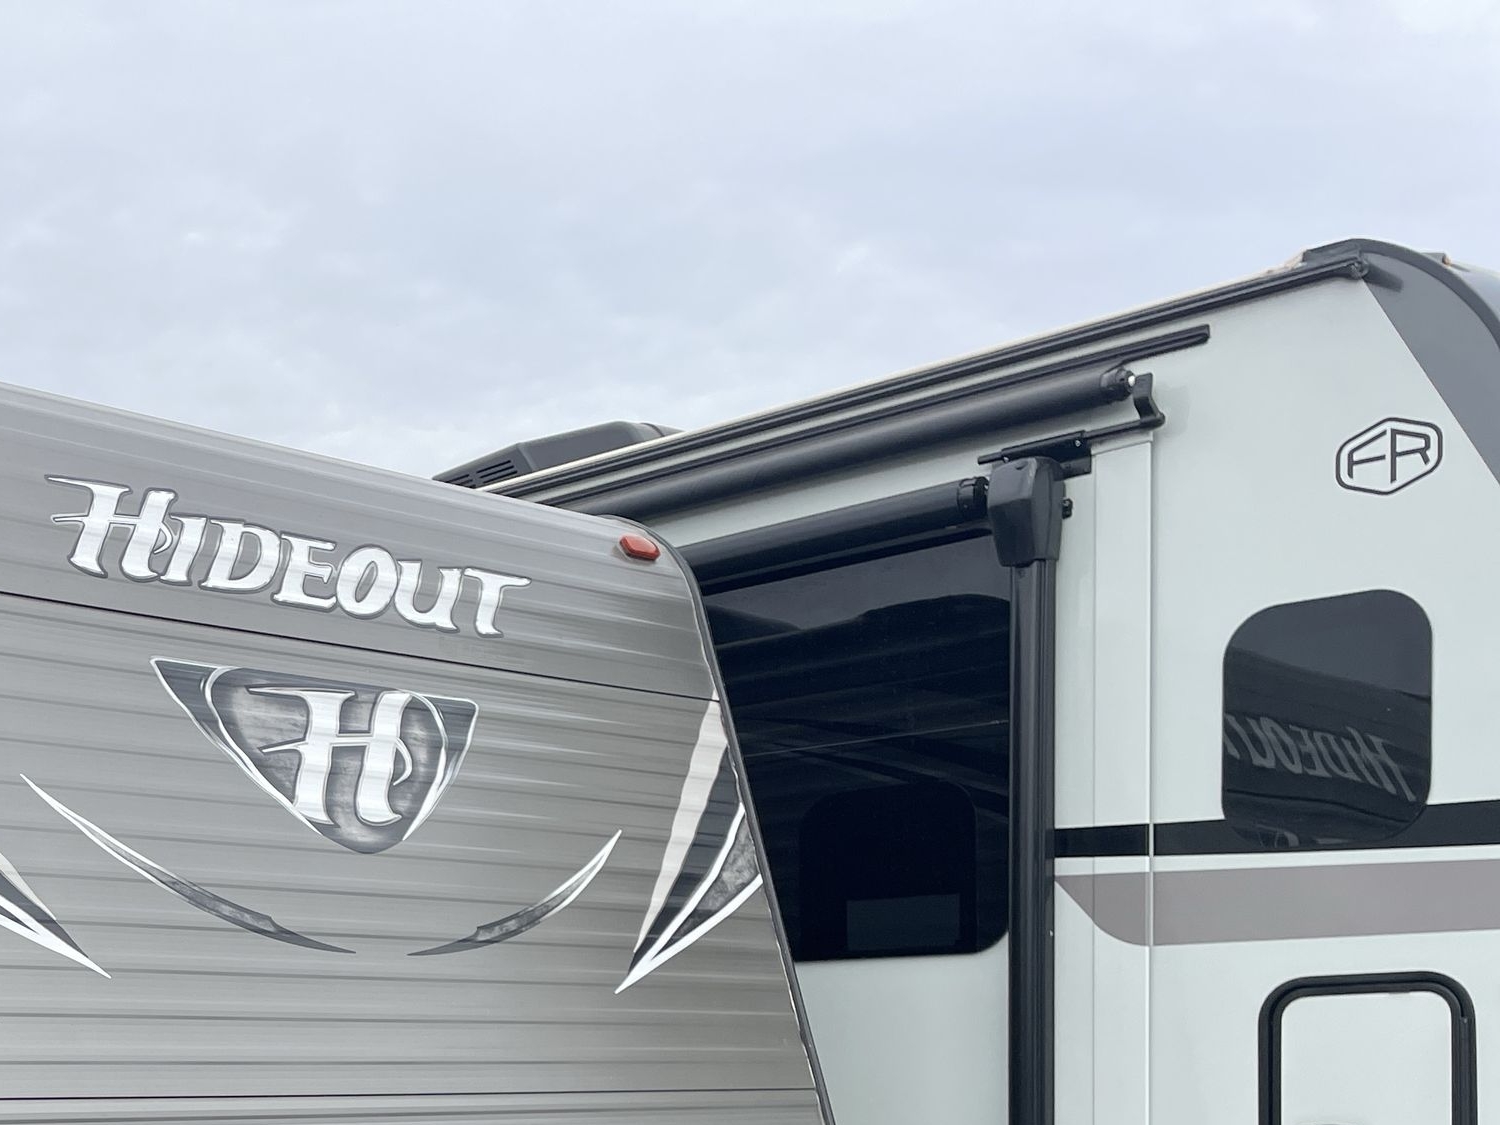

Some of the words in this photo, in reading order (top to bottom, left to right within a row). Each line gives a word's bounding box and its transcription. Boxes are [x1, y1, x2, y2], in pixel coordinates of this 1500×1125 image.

[1346, 427, 1431, 484] FR
[44, 474, 533, 638] HIDEOUT
[246, 684, 414, 826] H
